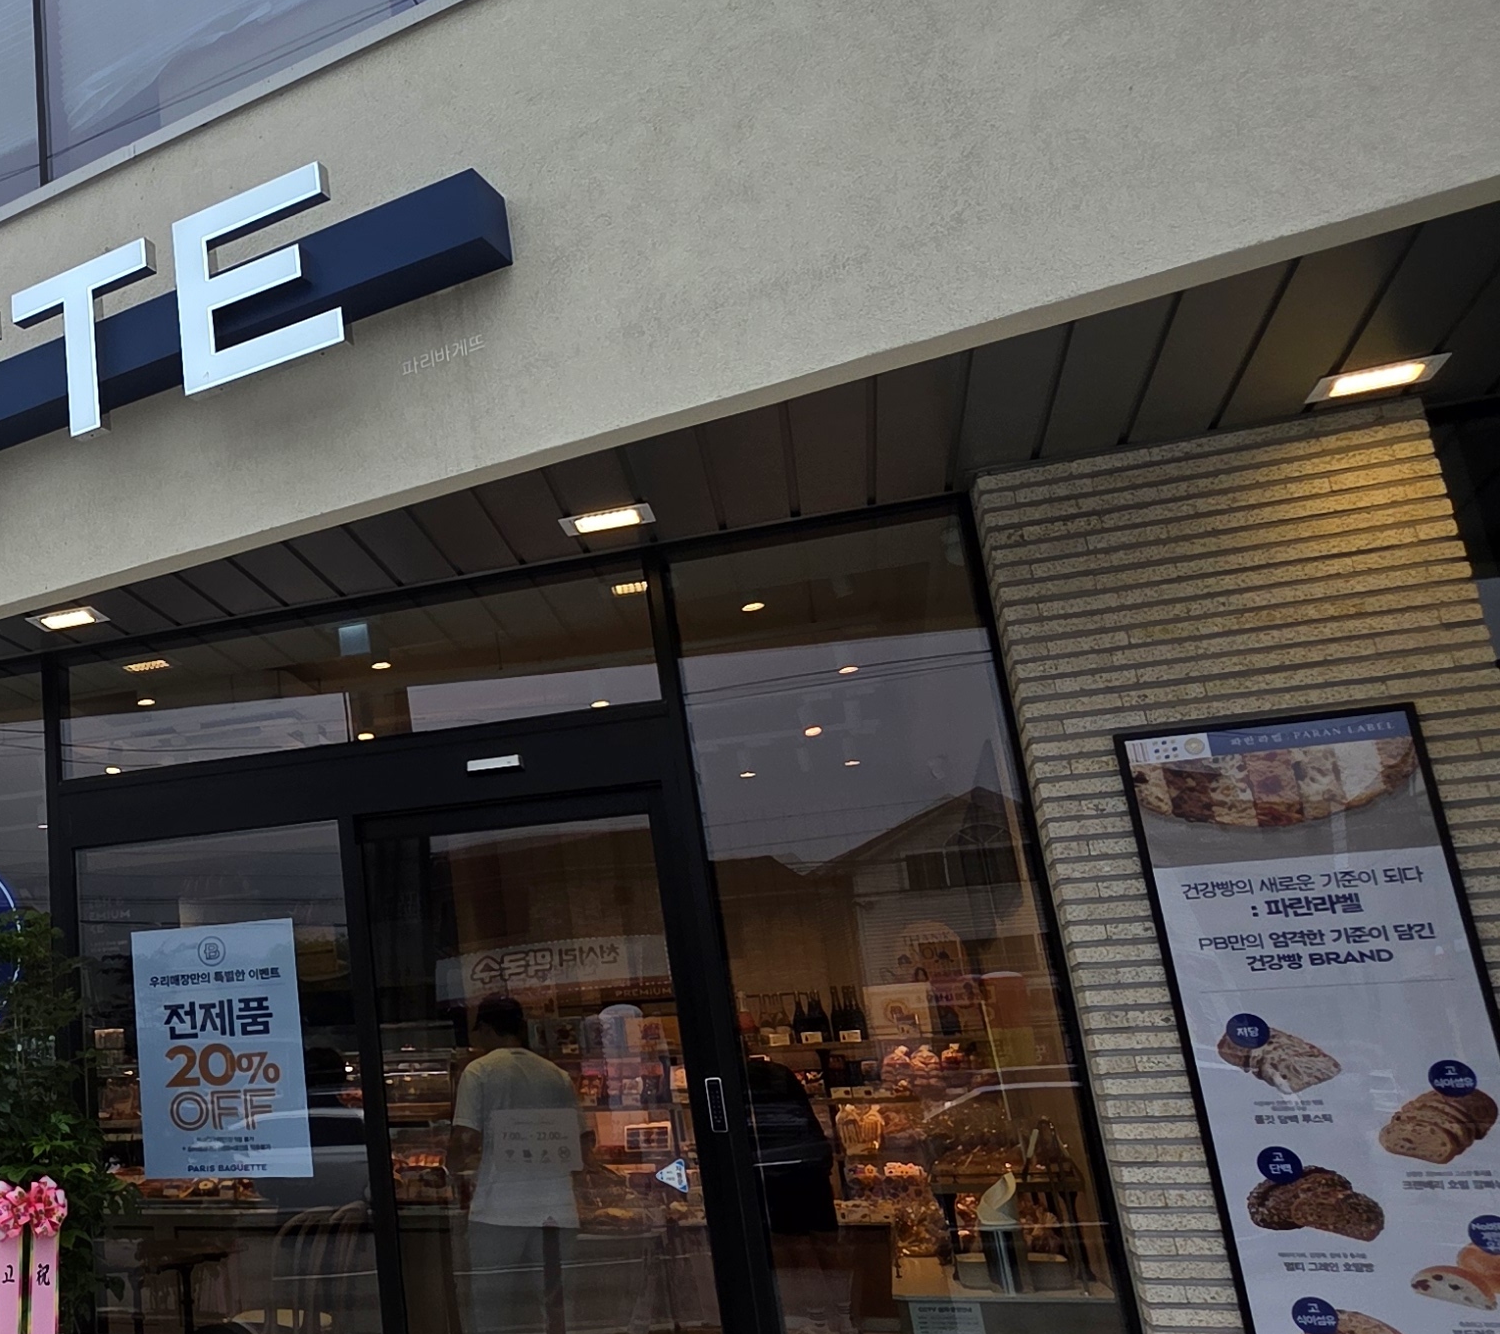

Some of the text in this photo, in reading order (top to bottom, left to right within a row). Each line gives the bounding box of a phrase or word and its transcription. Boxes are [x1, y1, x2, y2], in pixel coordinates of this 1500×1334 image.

[402, 333, 486, 376] 파리바게뜨
[1293, 727, 1342, 740] PARAN
[1347, 720, 1396, 735] LABEL
[1181, 865, 1425, 901] 건강빵의 새로운 기준이 되다
[1265, 892, 1364, 919] 파란라벨
[1199, 921, 1436, 952] PB만의 엄격한 기준이 담긴
[1246, 948, 1394, 972] 건강빵 BRAND
[149, 967, 281, 988] 우리매장만의 특별한 이벤트
[163, 996, 273, 1041] 전제품
[1236, 1026, 1259, 1038] 저당
[164, 1043, 280, 1089] 20%
[1444, 1065, 1458, 1076] 고
[170, 1088, 277, 1132] OFF
[1271, 1151, 1285, 1162] 고
[187, 1163, 268, 1173] PARIS BAGUETTE
[1268, 1163, 1294, 1175] 단백
[1306, 1302, 1321, 1313] 고
[1296, 1314, 1337, 1327] 식이섬유
